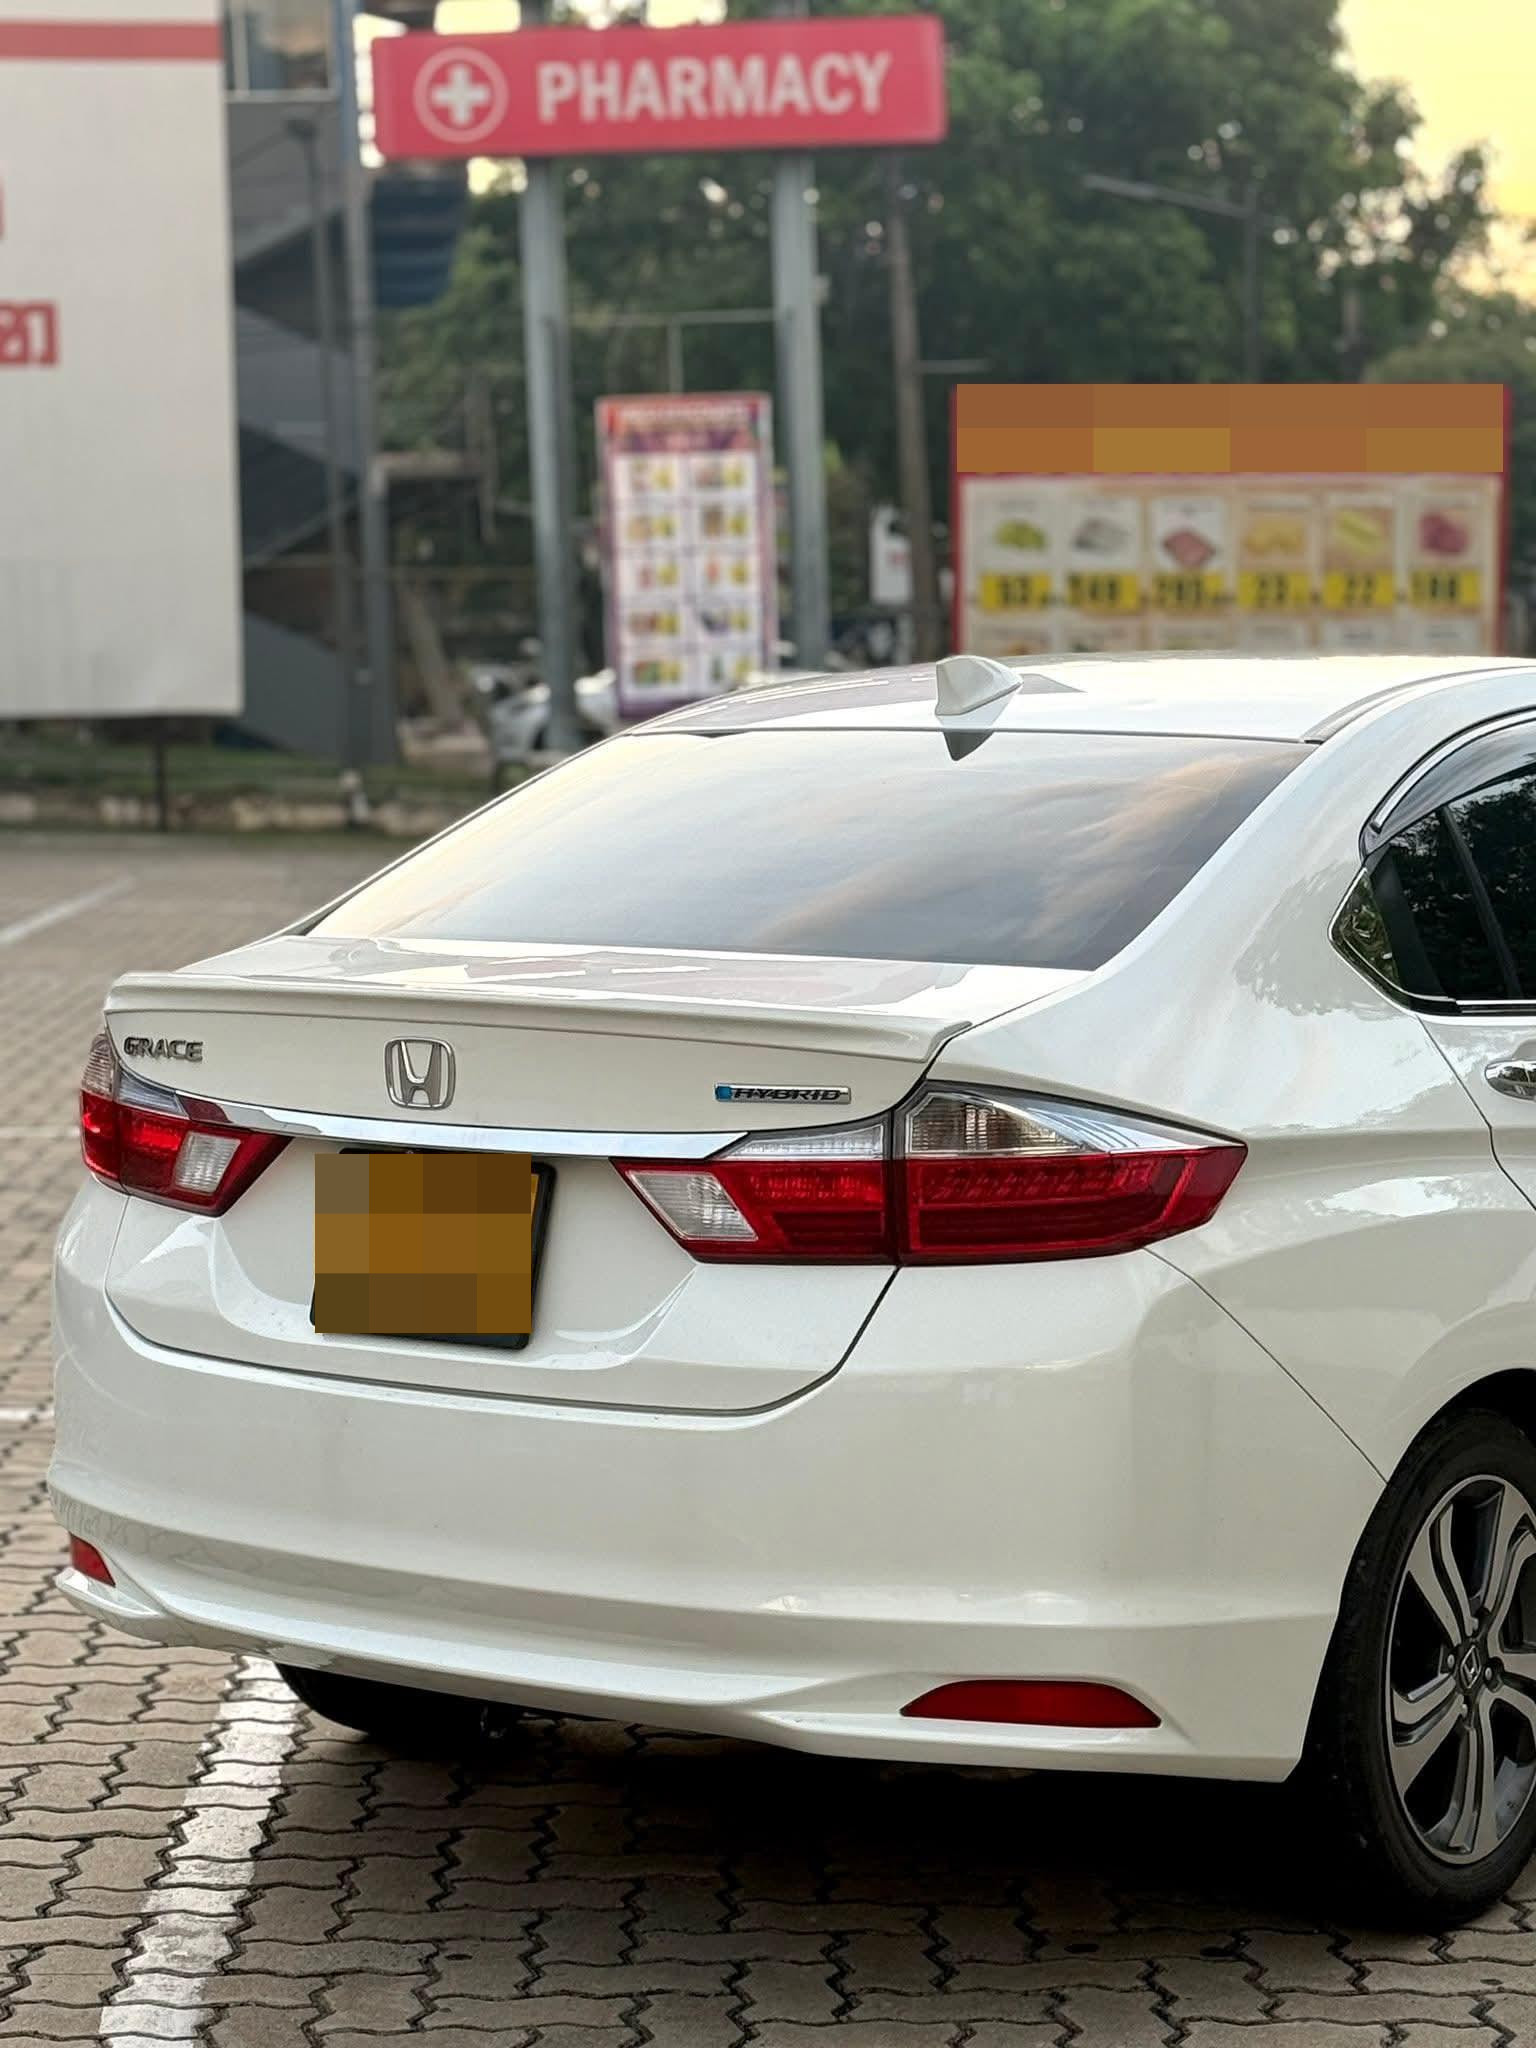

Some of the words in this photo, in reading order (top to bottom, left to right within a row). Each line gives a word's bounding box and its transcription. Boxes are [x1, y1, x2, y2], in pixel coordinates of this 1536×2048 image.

[537, 52, 891, 122] PHARMACY
[124, 1036, 203, 1062] GRACE
[733, 1087, 842, 1101] HYBRID
